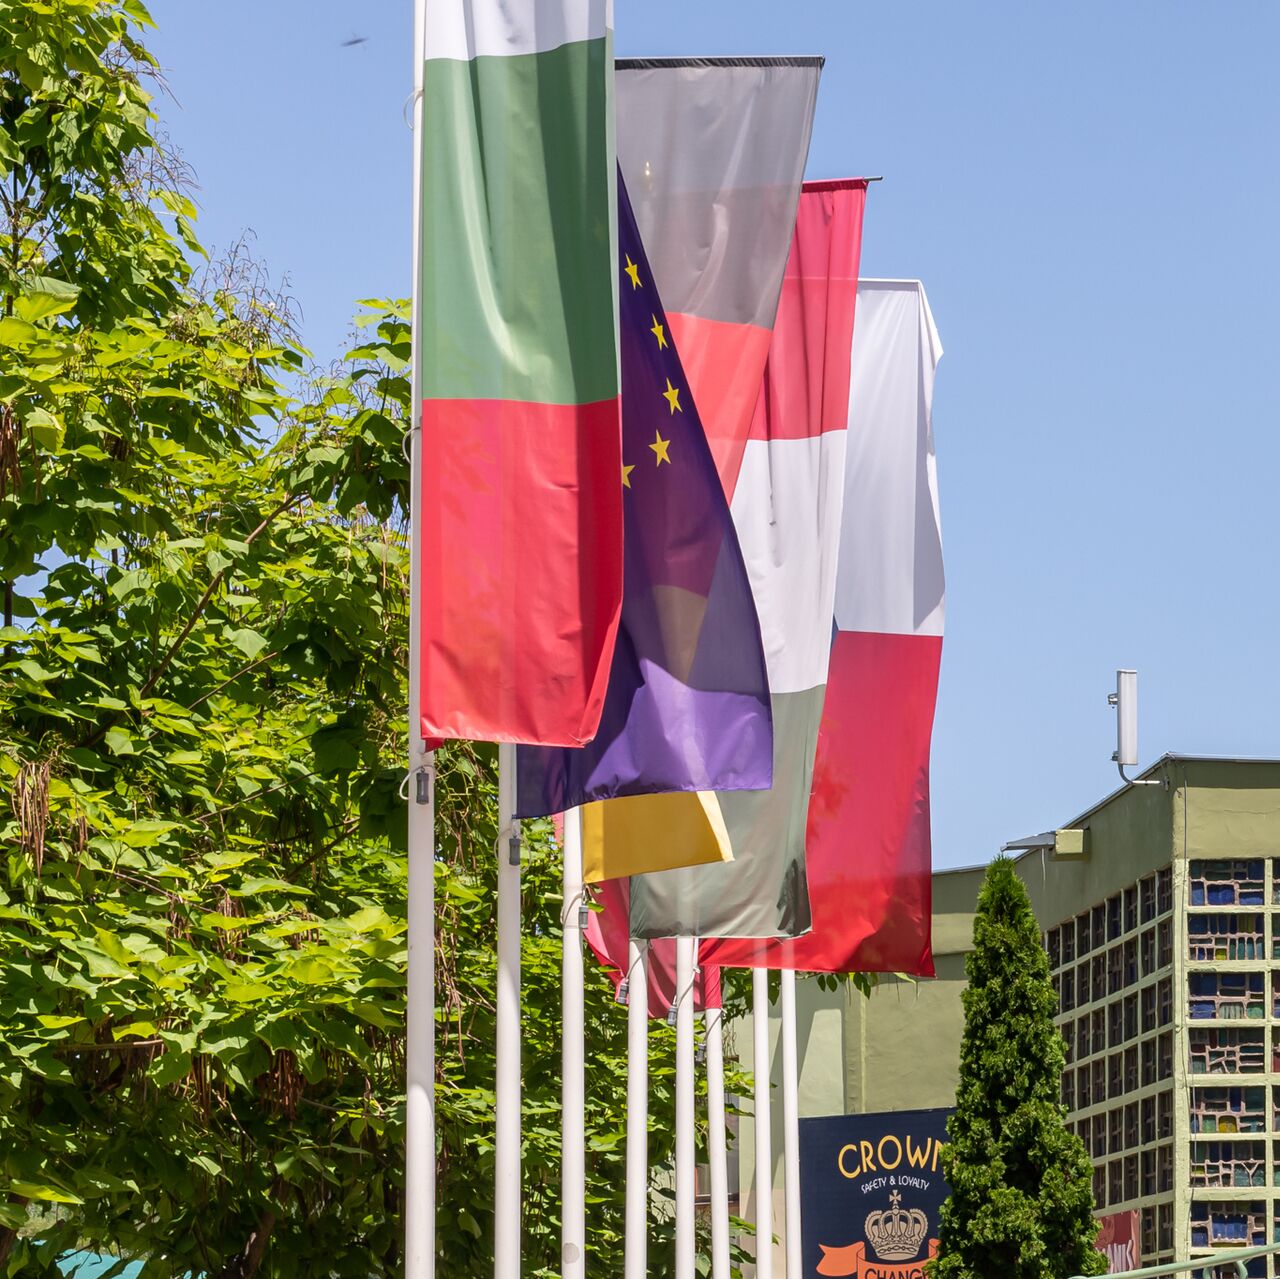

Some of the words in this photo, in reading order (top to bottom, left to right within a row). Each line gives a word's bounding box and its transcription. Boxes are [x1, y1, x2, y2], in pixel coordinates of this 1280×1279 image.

[861, 1177, 887, 1194] SAFETY
[889, 1175, 896, 1186] &
[898, 1175, 930, 1191] LOYALTY
